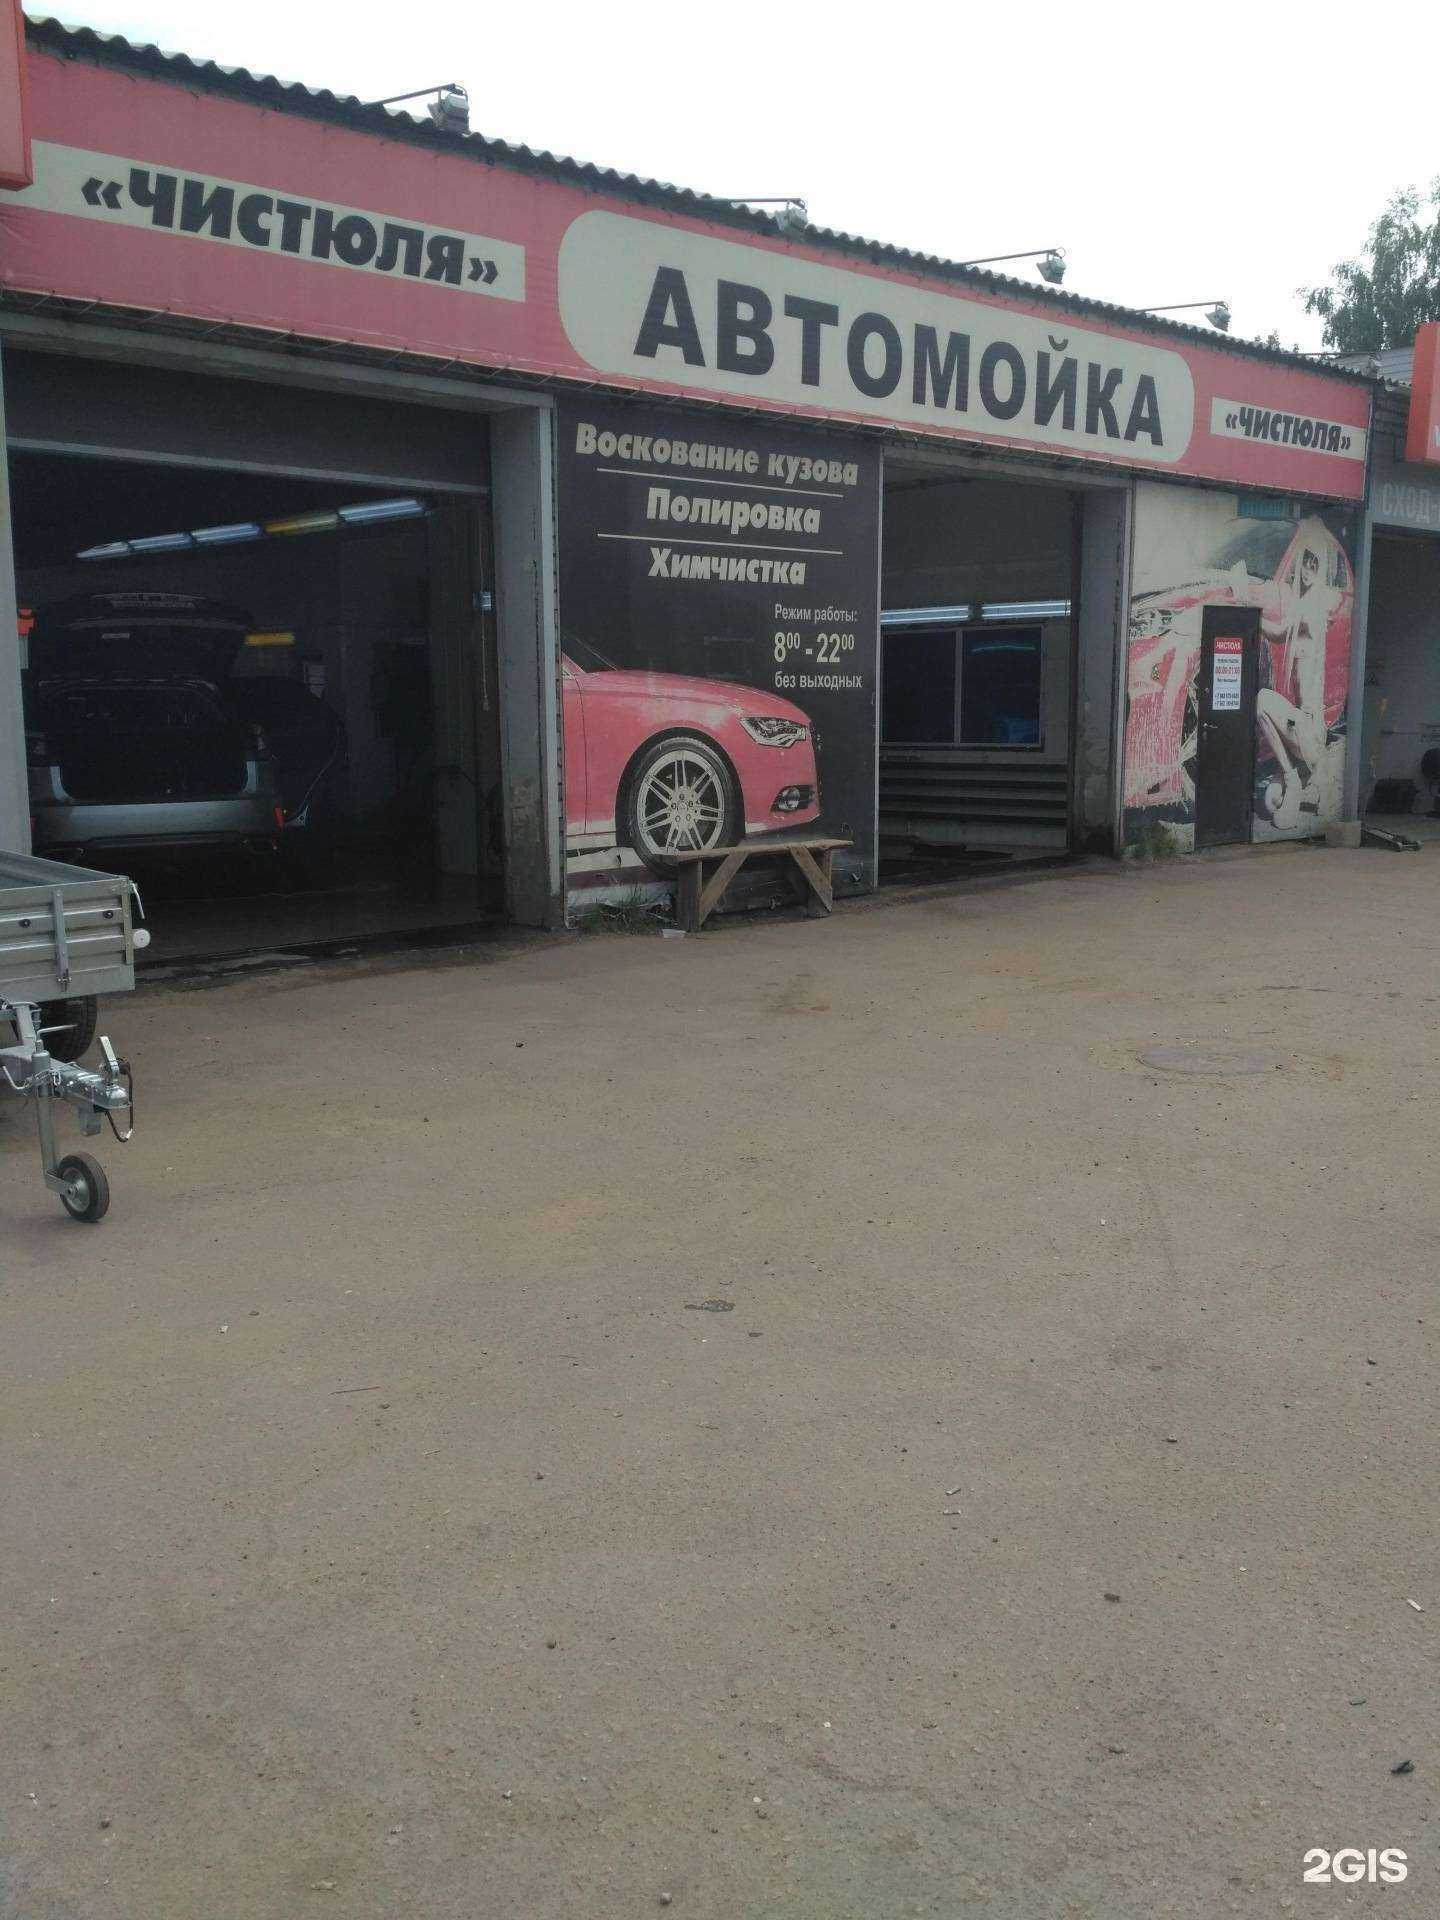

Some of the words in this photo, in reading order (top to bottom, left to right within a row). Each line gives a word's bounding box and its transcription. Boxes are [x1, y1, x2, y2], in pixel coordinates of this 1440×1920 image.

[81, 168, 498, 285] «ЧИСТЮЛЯ»
[633, 266, 1163, 446] АВТОМОЙКА
[1226, 407, 1351, 452] «ЧИСТЮЛЯ»
[575, 422, 760, 474] Воскование
[767, 453, 858, 486] кузова
[646, 487, 821, 535] Полировка
[1382, 482, 1440, 525] СХОД-
[648, 547, 807, 585] Химчистка
[774, 603, 812, 620] Режим
[814, 606, 858, 624] работы:
[774, 670, 797, 688] без
[799, 674, 863, 690] выходных
